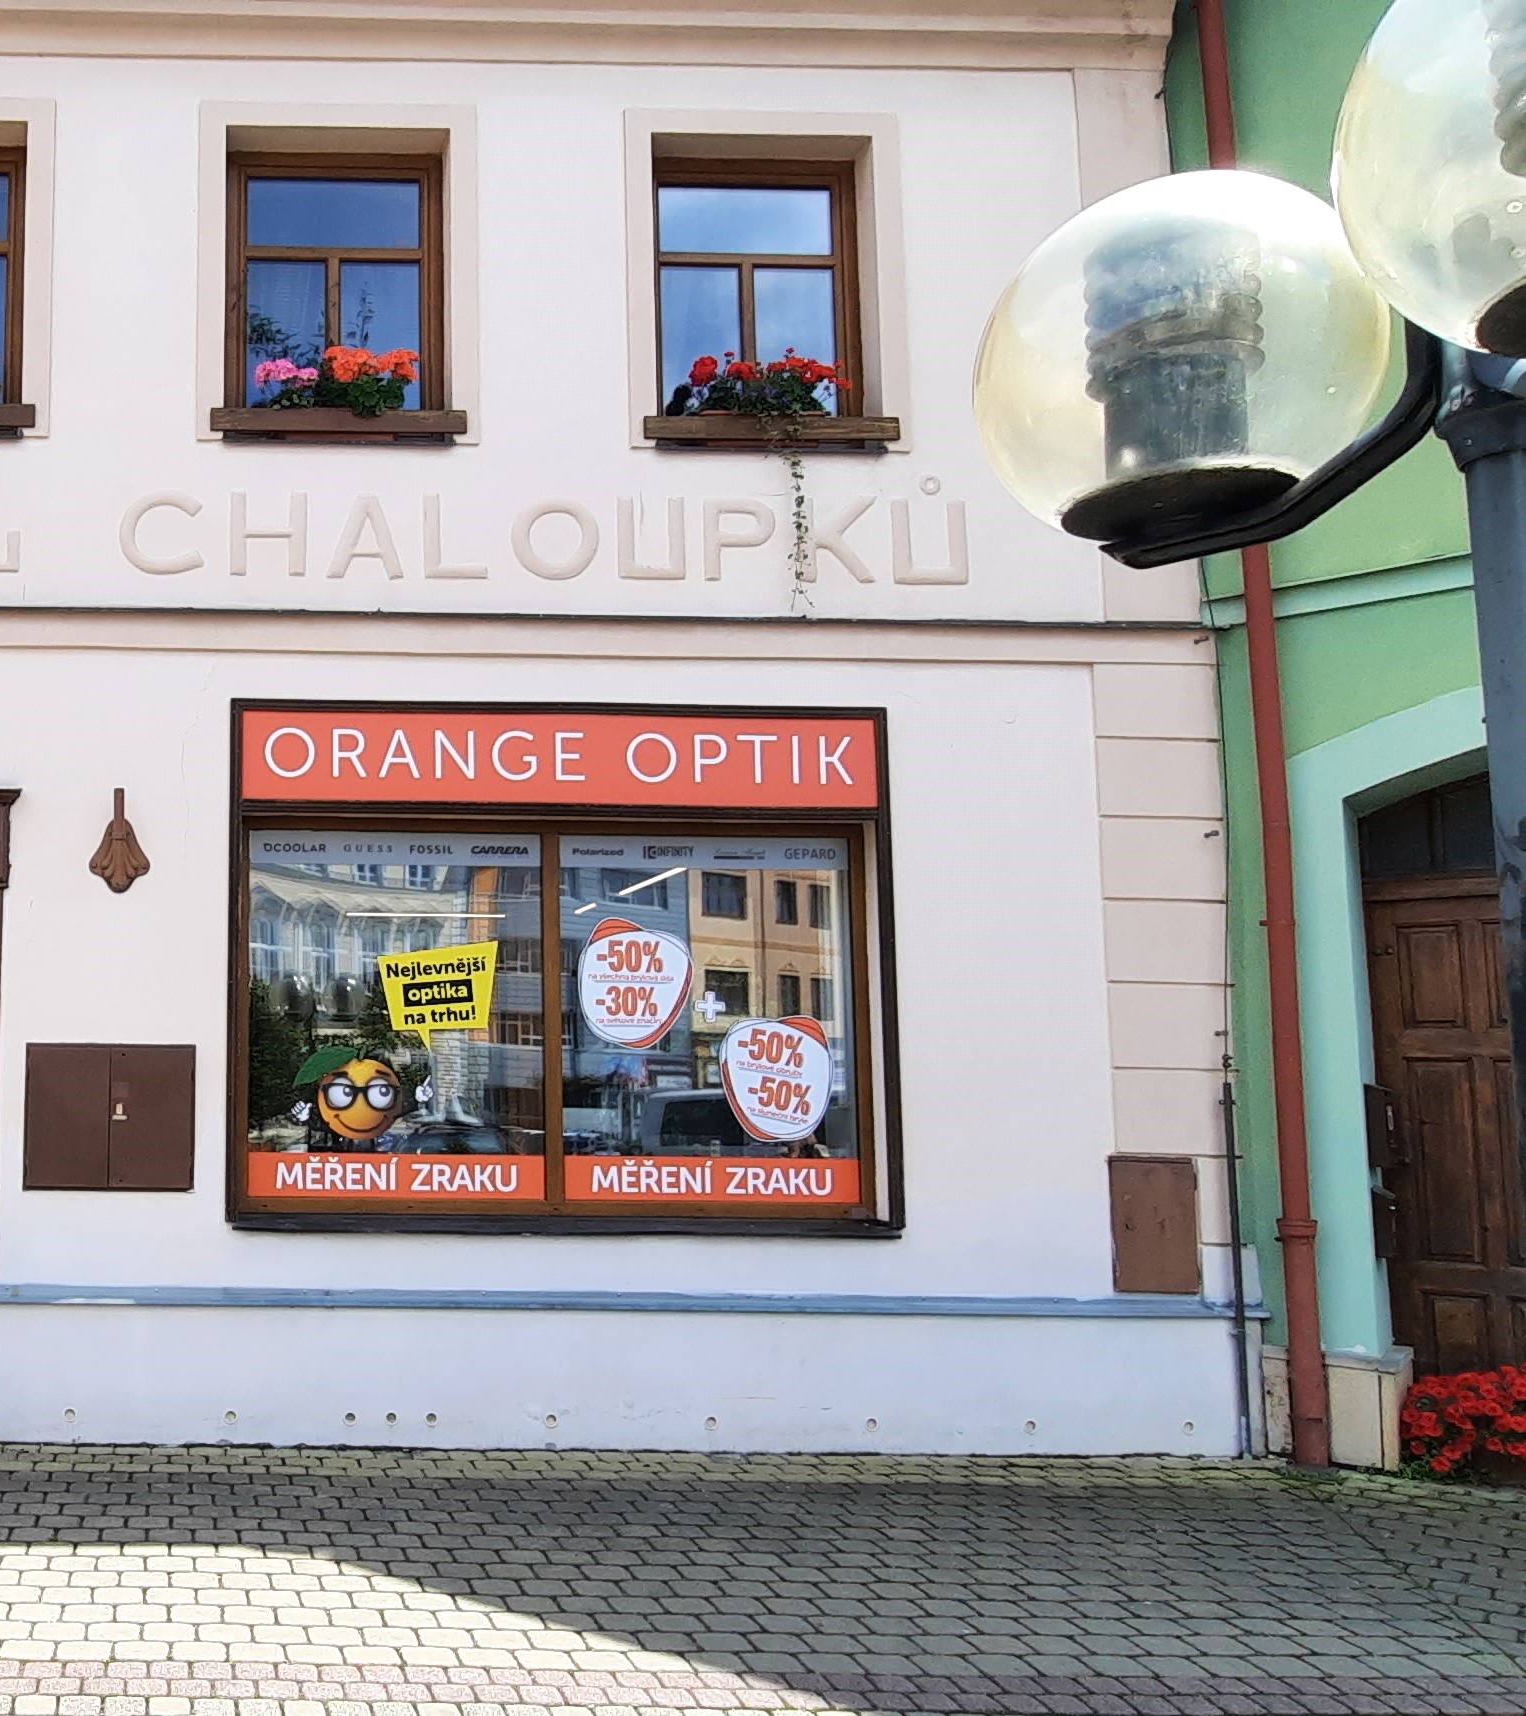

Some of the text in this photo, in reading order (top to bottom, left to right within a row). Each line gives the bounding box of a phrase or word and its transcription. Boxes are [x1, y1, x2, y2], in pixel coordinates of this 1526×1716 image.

[118, 474, 970, 587] CHALOUPKŮ
[263, 726, 855, 786] ORANGE OPTIK
[343, 843, 393, 854] GUESS
[409, 844, 454, 855] FOSSIL
[470, 845, 530, 856] CARRERA
[572, 847, 625, 857] Polarized
[784, 848, 836, 860] GEPARD
[385, 956, 487, 981] Nejlevnější
[596, 939, 664, 974] -50%
[407, 983, 469, 1005] optika
[595, 985, 658, 1017] -30%
[403, 1005, 477, 1025] na trhu!
[737, 1028, 805, 1068] -50%
[747, 1075, 812, 1116] -50%
[275, 1155, 519, 1193] MĚŘENÍ ZRAKU
[591, 1159, 833, 1196] MĚŘENÍ ZRAKU
